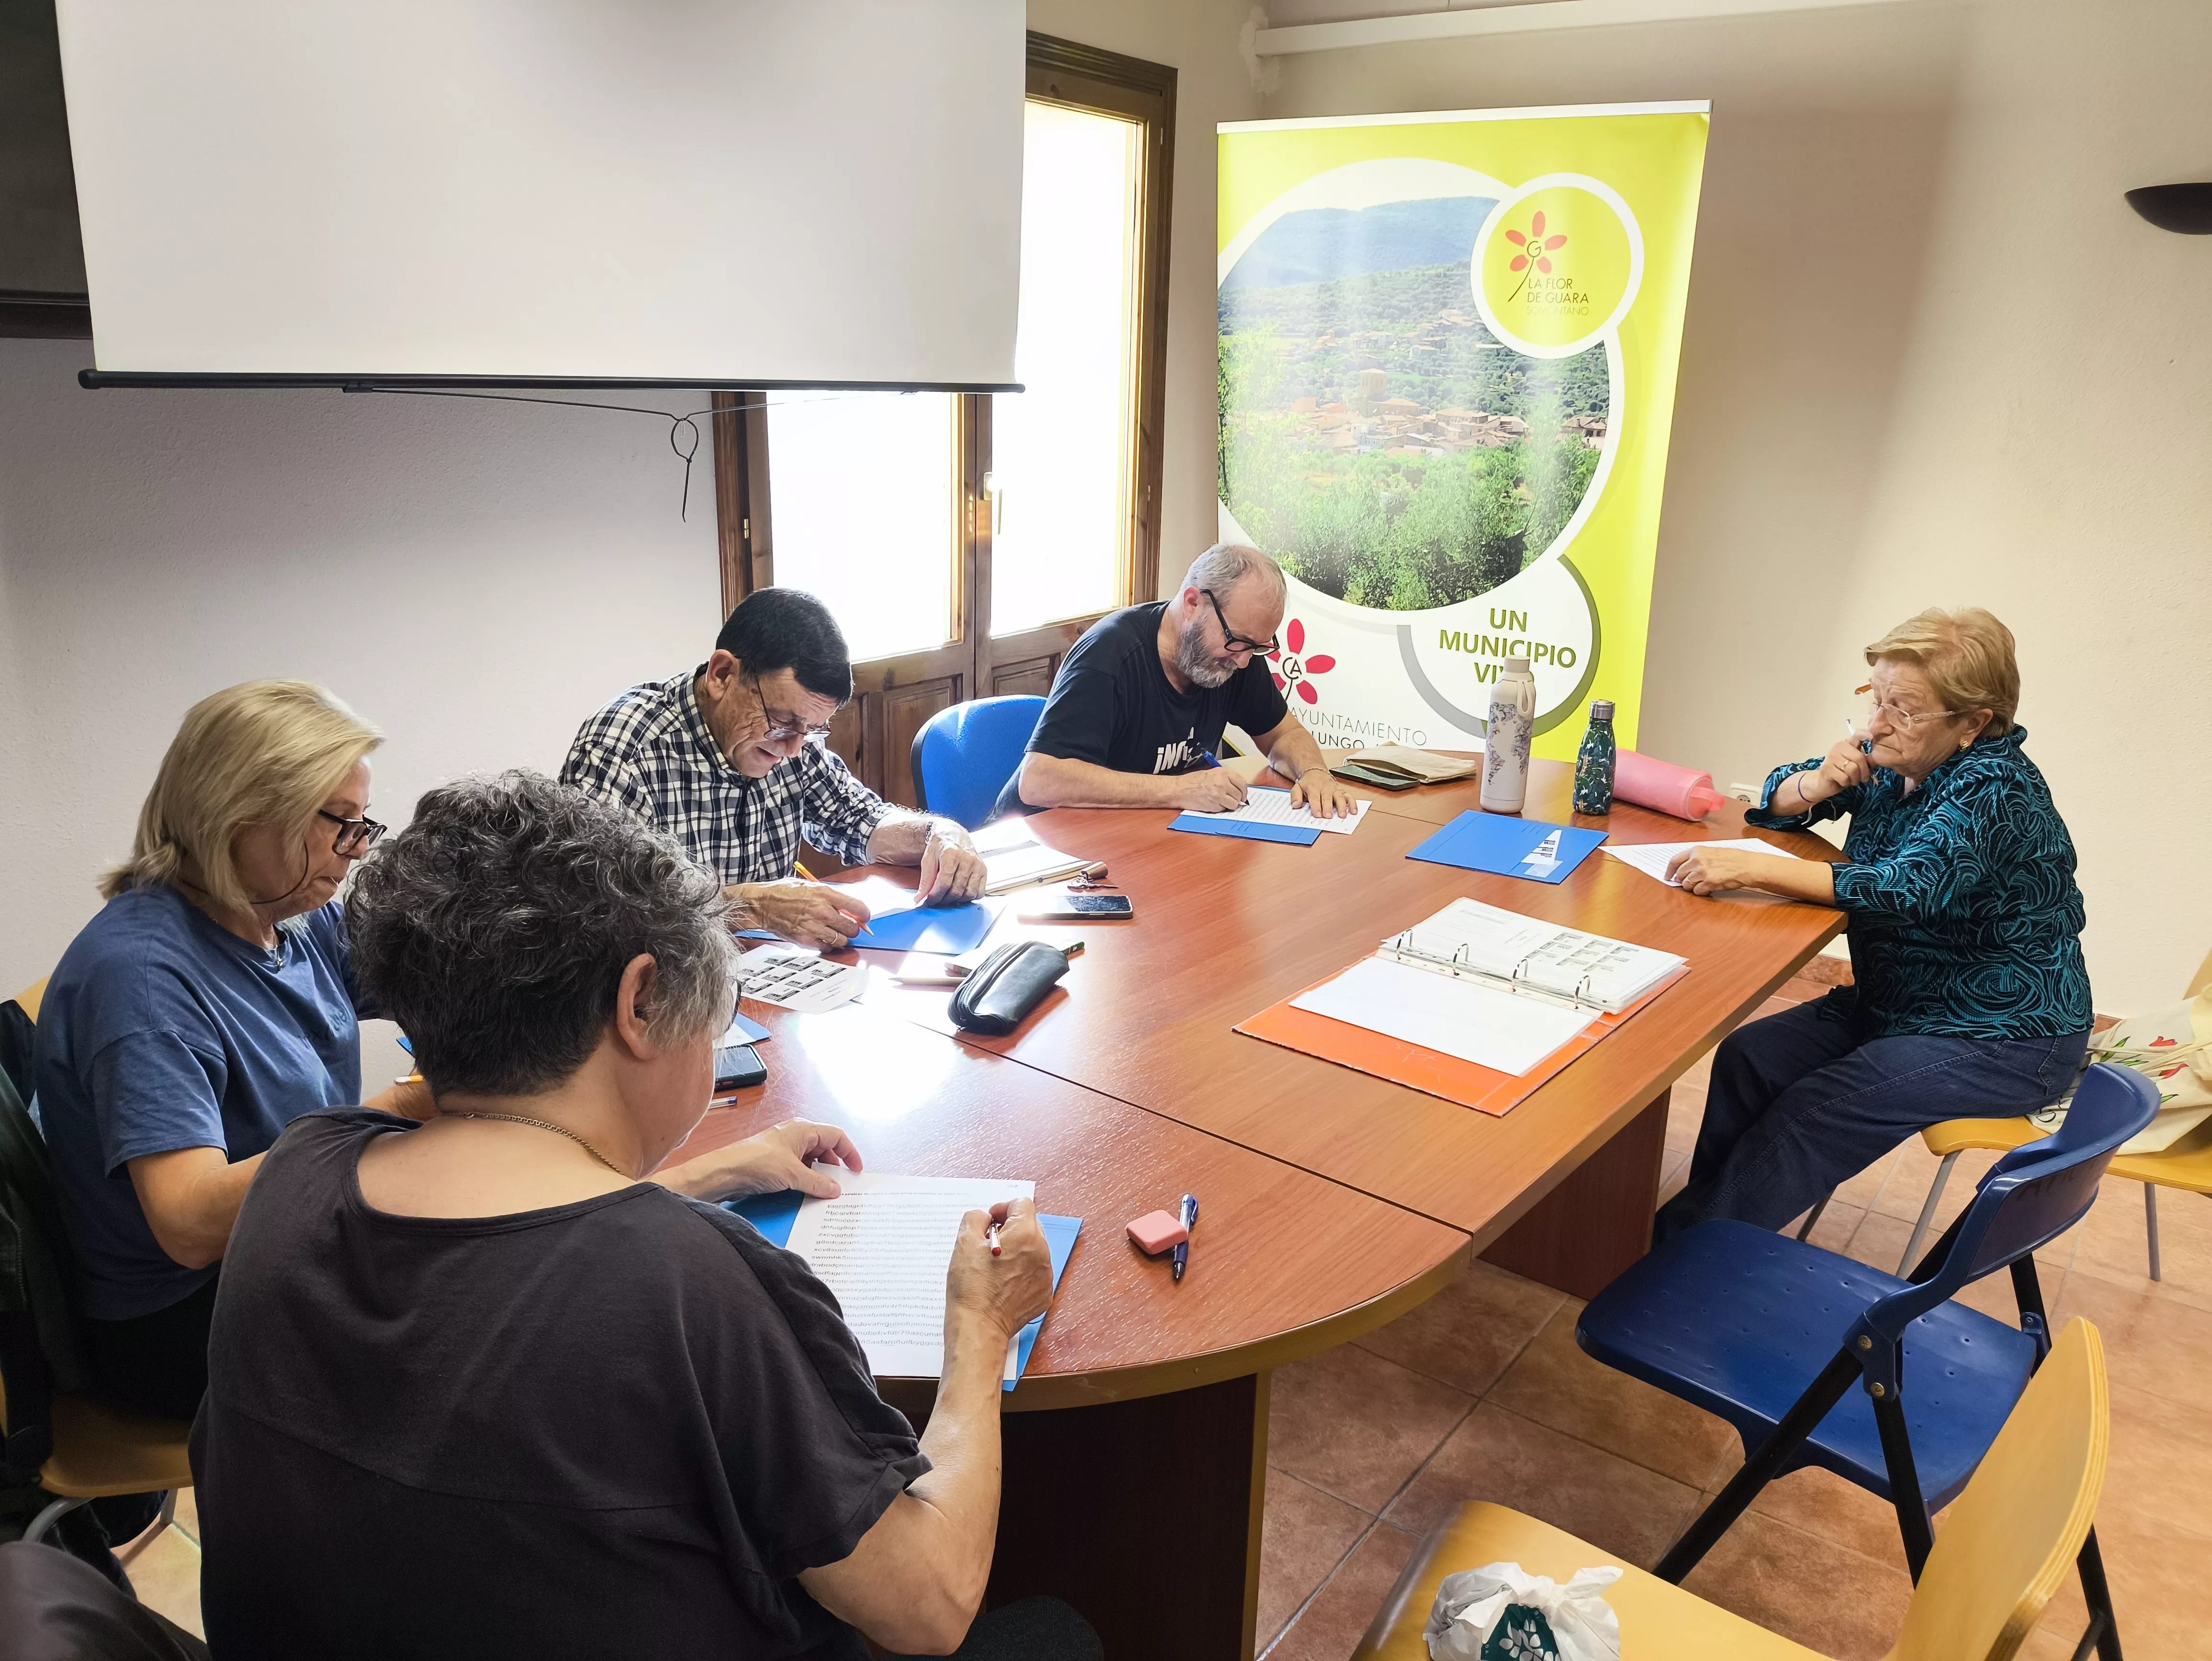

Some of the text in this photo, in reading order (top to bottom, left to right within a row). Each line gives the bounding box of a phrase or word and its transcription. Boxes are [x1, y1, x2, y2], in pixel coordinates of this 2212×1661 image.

[1528, 278, 1573, 289] LA FLOR
[1527, 292, 1589, 304] DE GUARA
[1526, 306, 1589, 316] SOMONTANO
[1490, 608, 1527, 632] UN
[1439, 630, 1577, 668] MUNICIPIO
[1290, 707, 1427, 746] AYUNTAMIENTO
